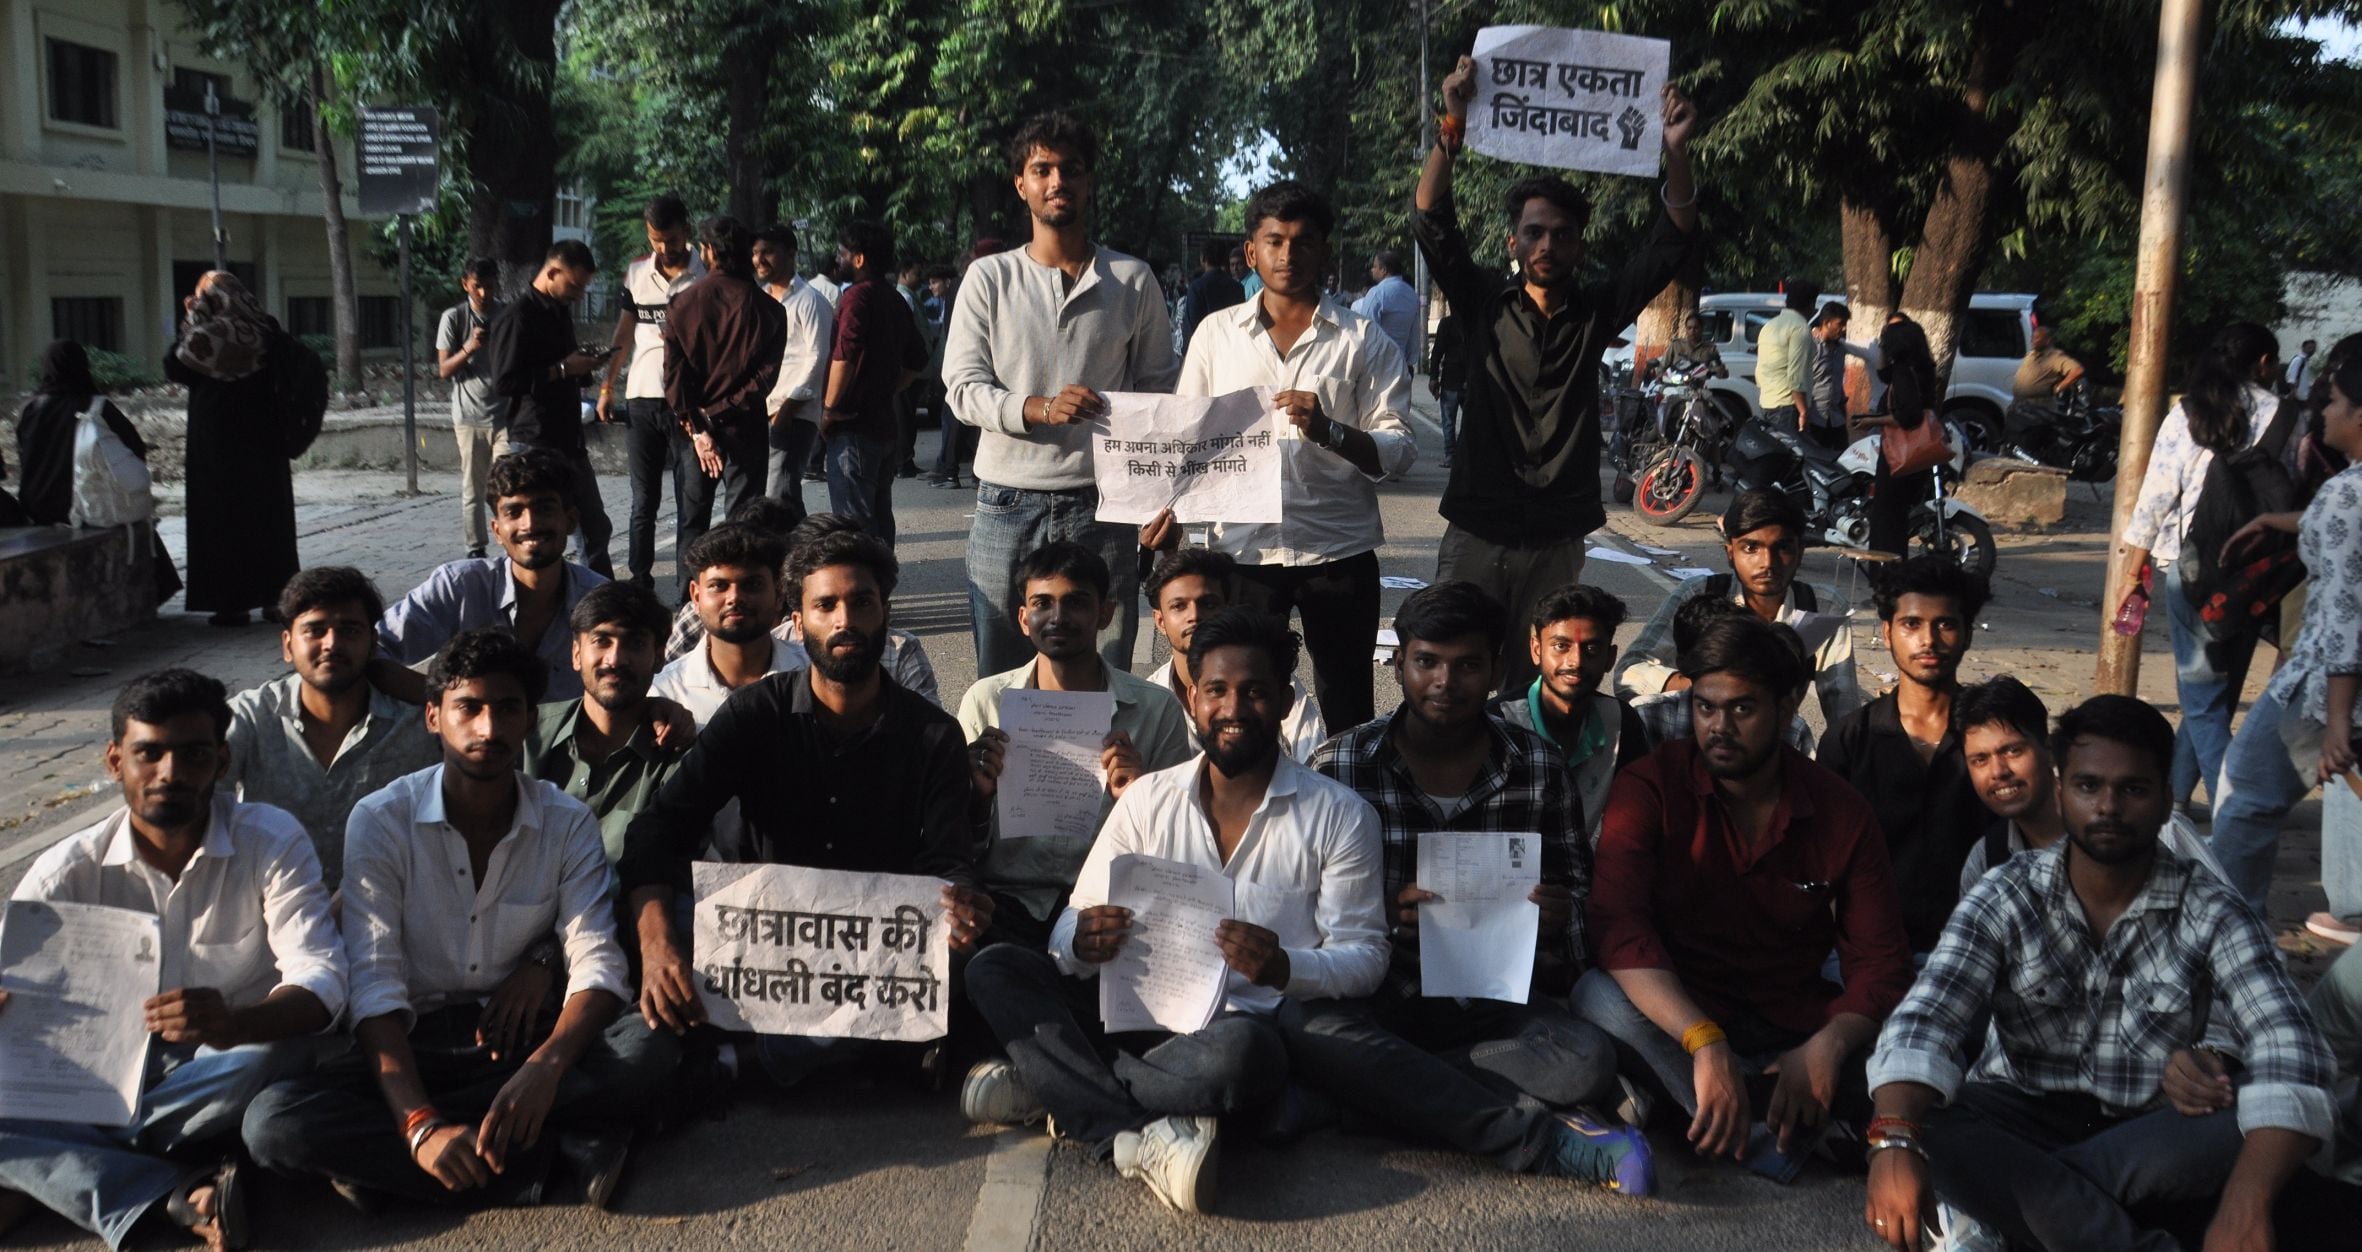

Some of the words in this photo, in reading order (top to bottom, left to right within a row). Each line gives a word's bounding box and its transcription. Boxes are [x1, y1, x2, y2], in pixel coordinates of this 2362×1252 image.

[1491, 58, 1552, 89] छात्र
[1557, 63, 1645, 98] एकता
[1490, 92, 1613, 142] जिंदाबाद
[1104, 439, 1121, 453] हम
[1124, 439, 1157, 454] अपना
[1209, 431, 1244, 450] मांगते
[1247, 430, 1272, 449] नहीं
[1128, 459, 1161, 477] किसी
[1165, 461, 1176, 477] से
[1211, 454, 1247, 474] मांगते
[714, 903, 873, 952] छात्रावास
[880, 904, 932, 954] की
[703, 957, 814, 1004] धांधली
[819, 963, 870, 1010] बंद
[875, 965, 941, 1012] करो
